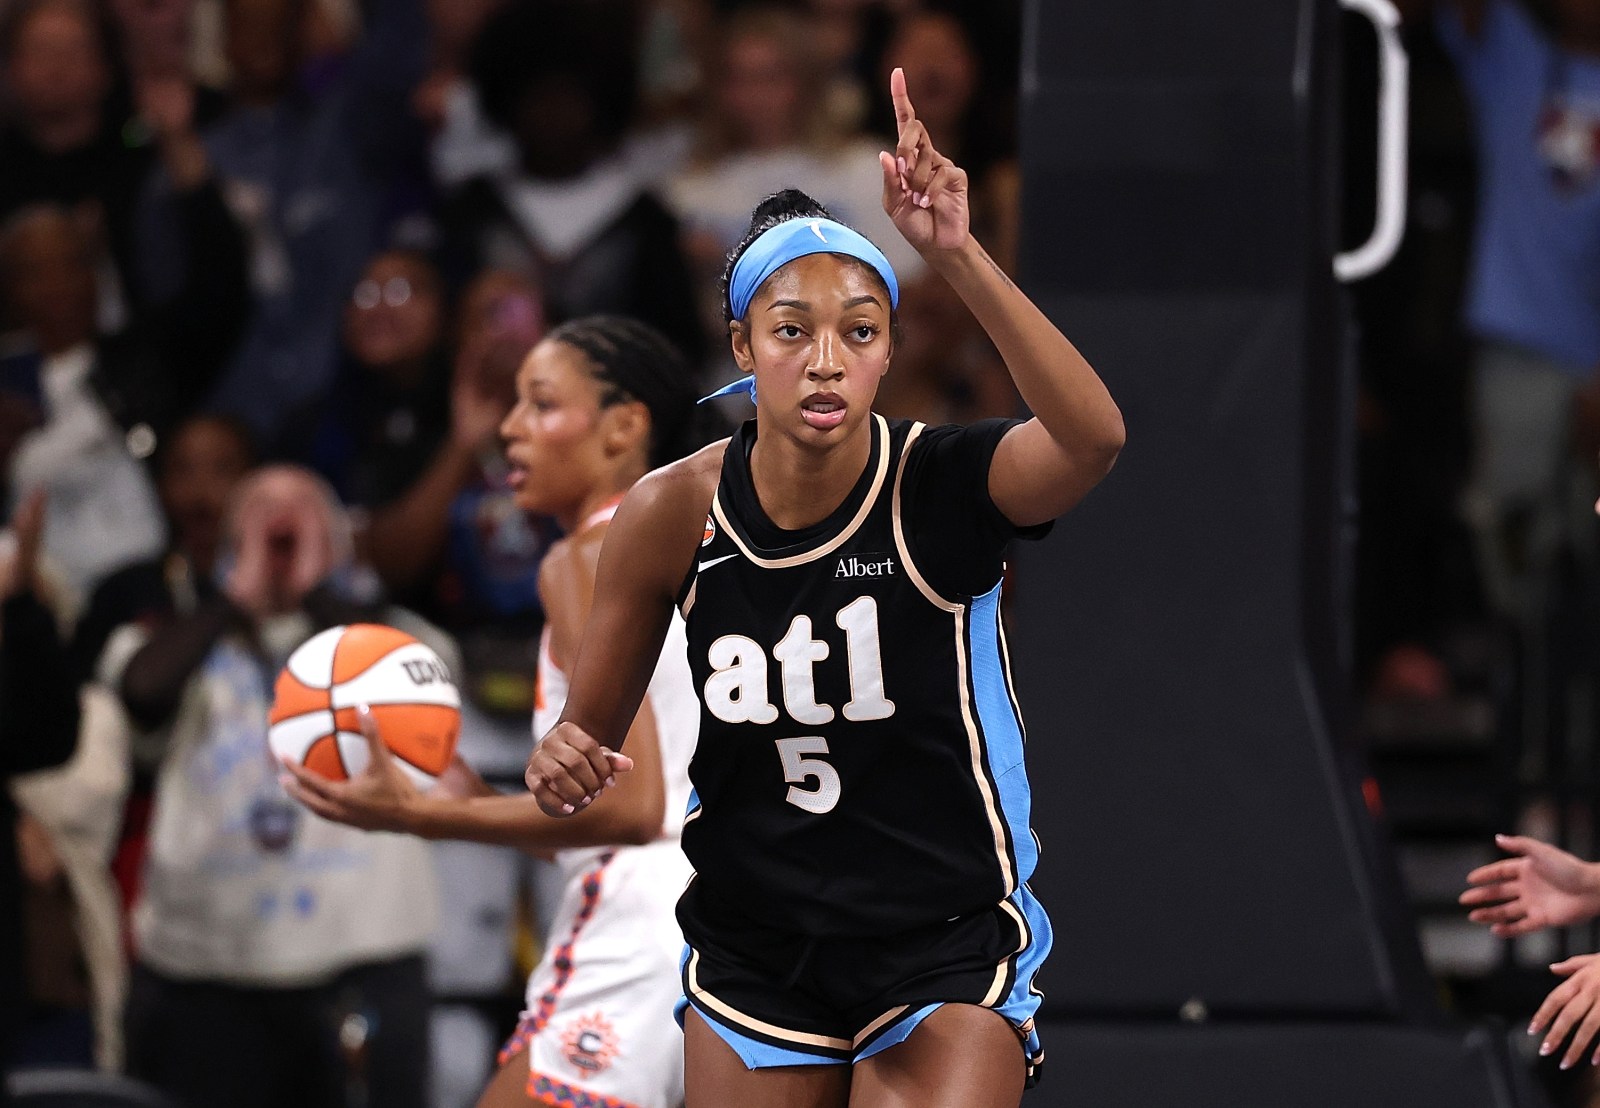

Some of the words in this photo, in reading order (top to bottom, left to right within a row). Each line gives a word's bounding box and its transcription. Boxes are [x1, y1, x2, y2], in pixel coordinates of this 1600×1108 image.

[834, 557, 895, 578] Albert
[704, 595, 896, 725] atl
[774, 736, 842, 814] 5
